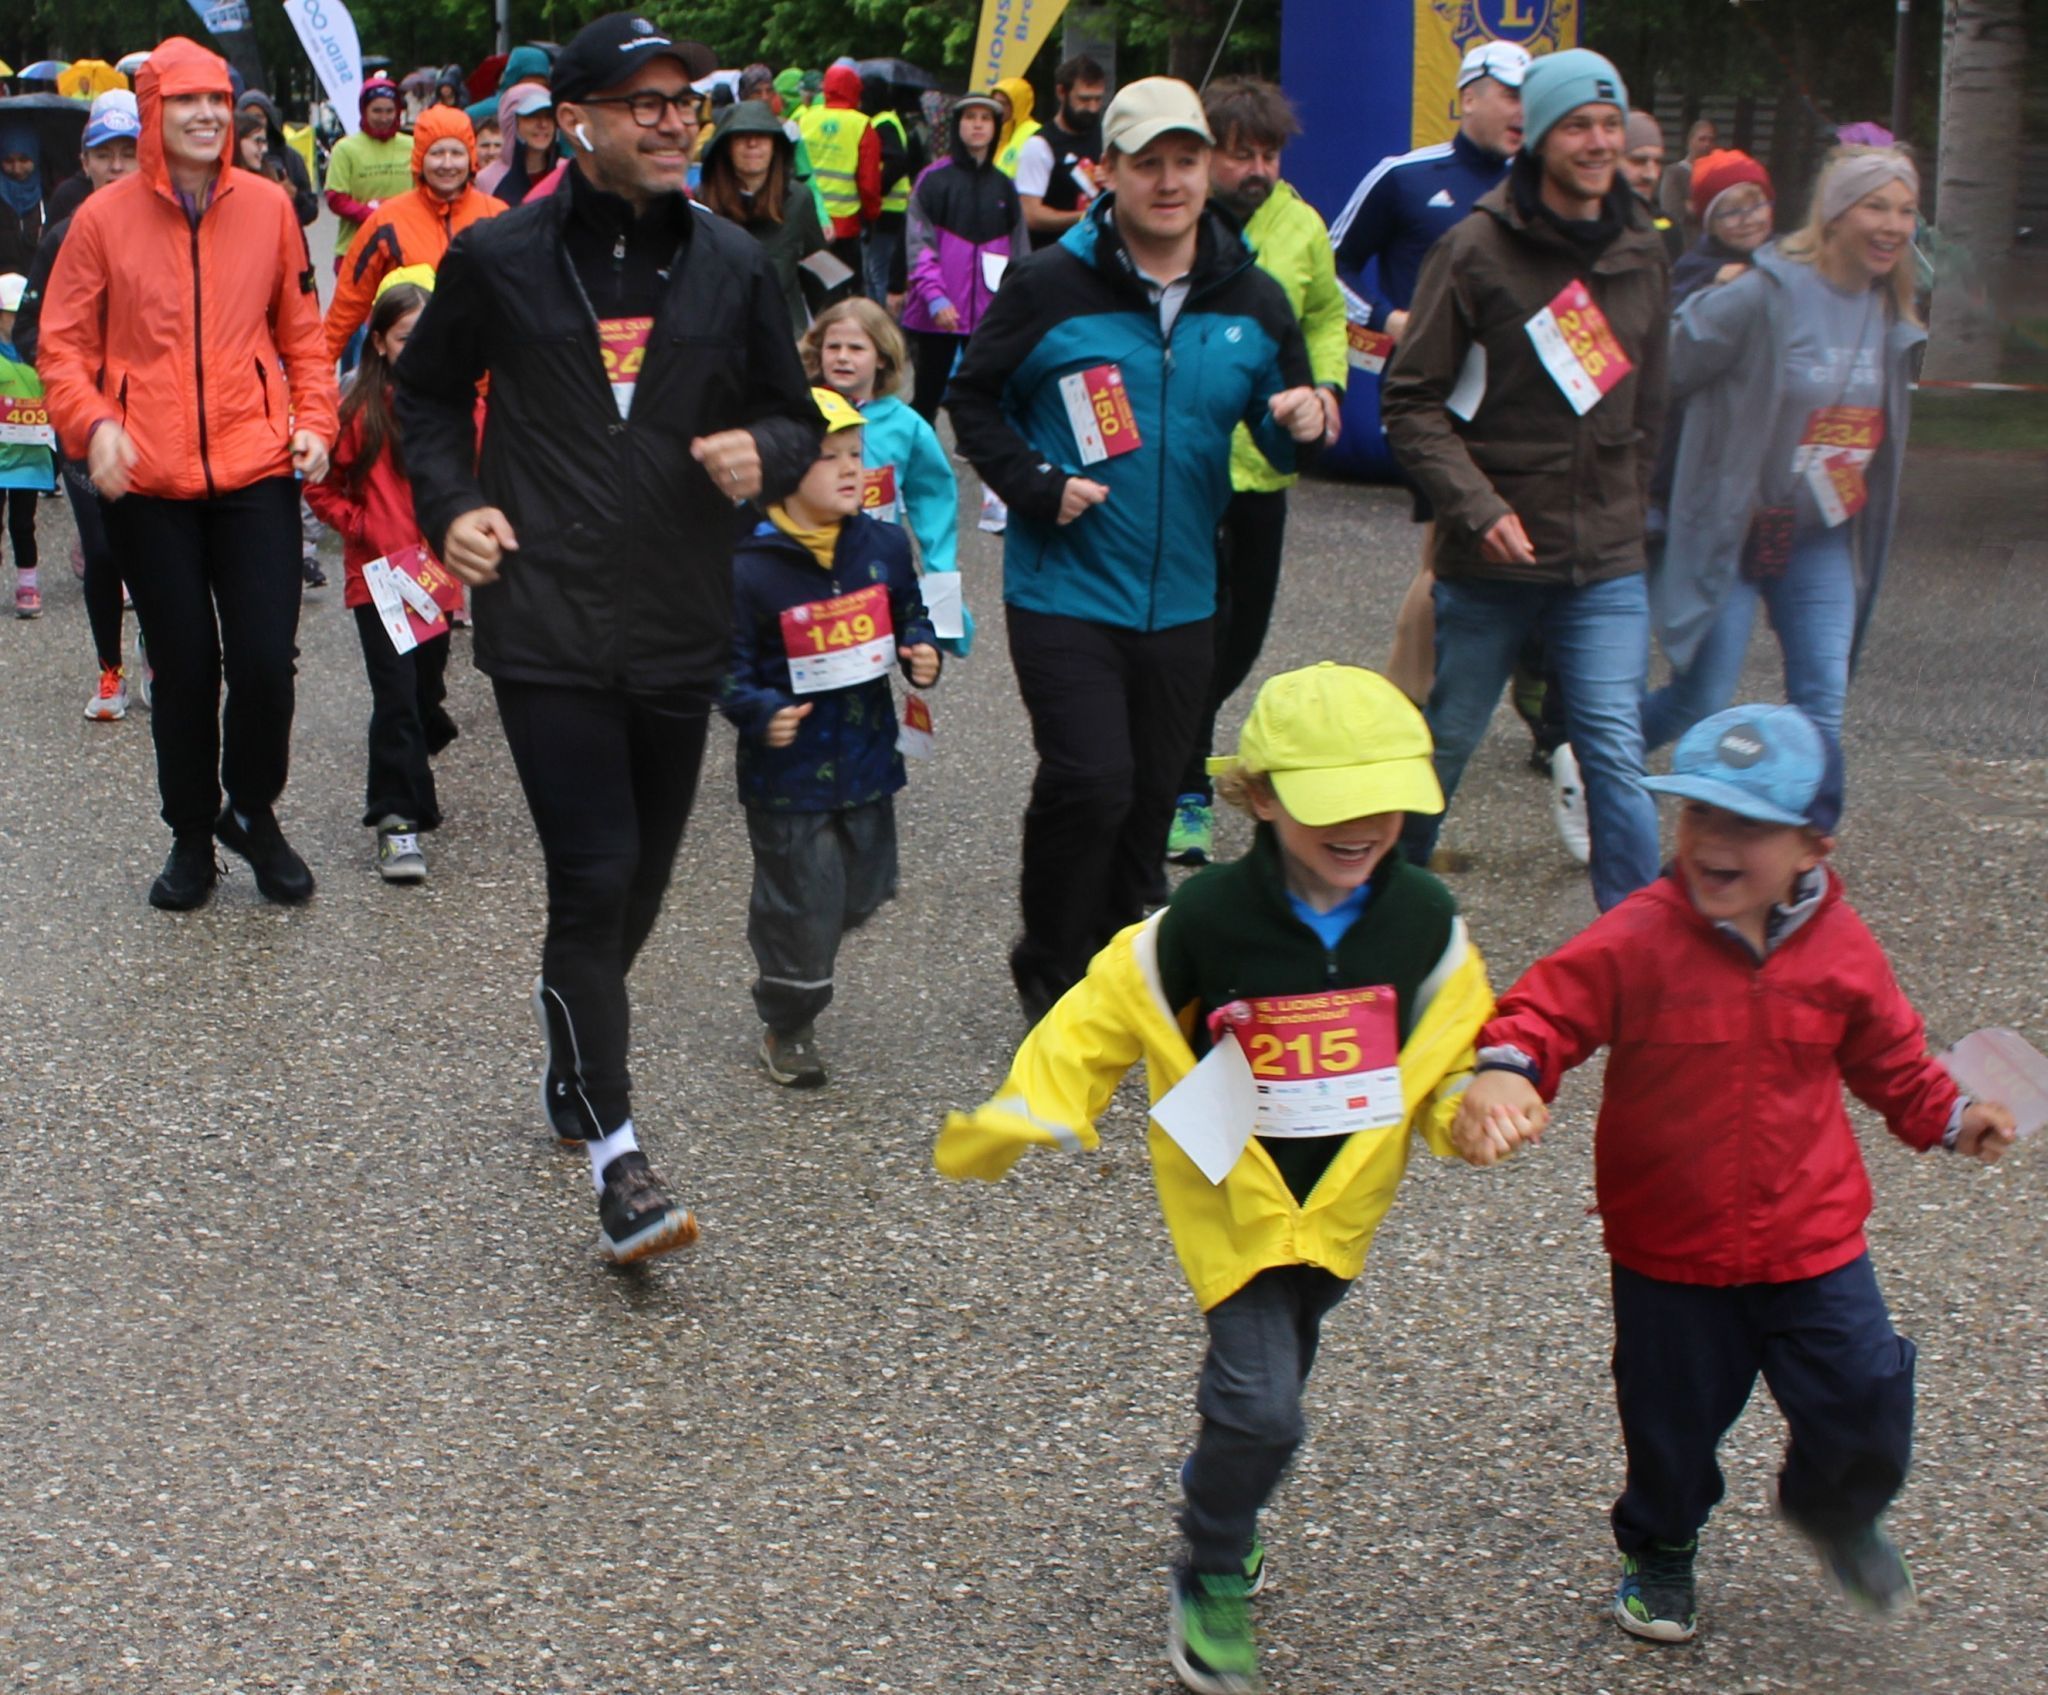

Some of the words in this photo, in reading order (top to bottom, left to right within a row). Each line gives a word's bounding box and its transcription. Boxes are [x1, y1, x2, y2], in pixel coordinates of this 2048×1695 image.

[1557, 308, 1609, 377] 235
[6, 409, 48, 425] 403
[1091, 387, 1120, 437] 150
[1811, 421, 1873, 447] 234
[806, 613, 875, 652] 149
[1250, 1028, 1362, 1076] 215
